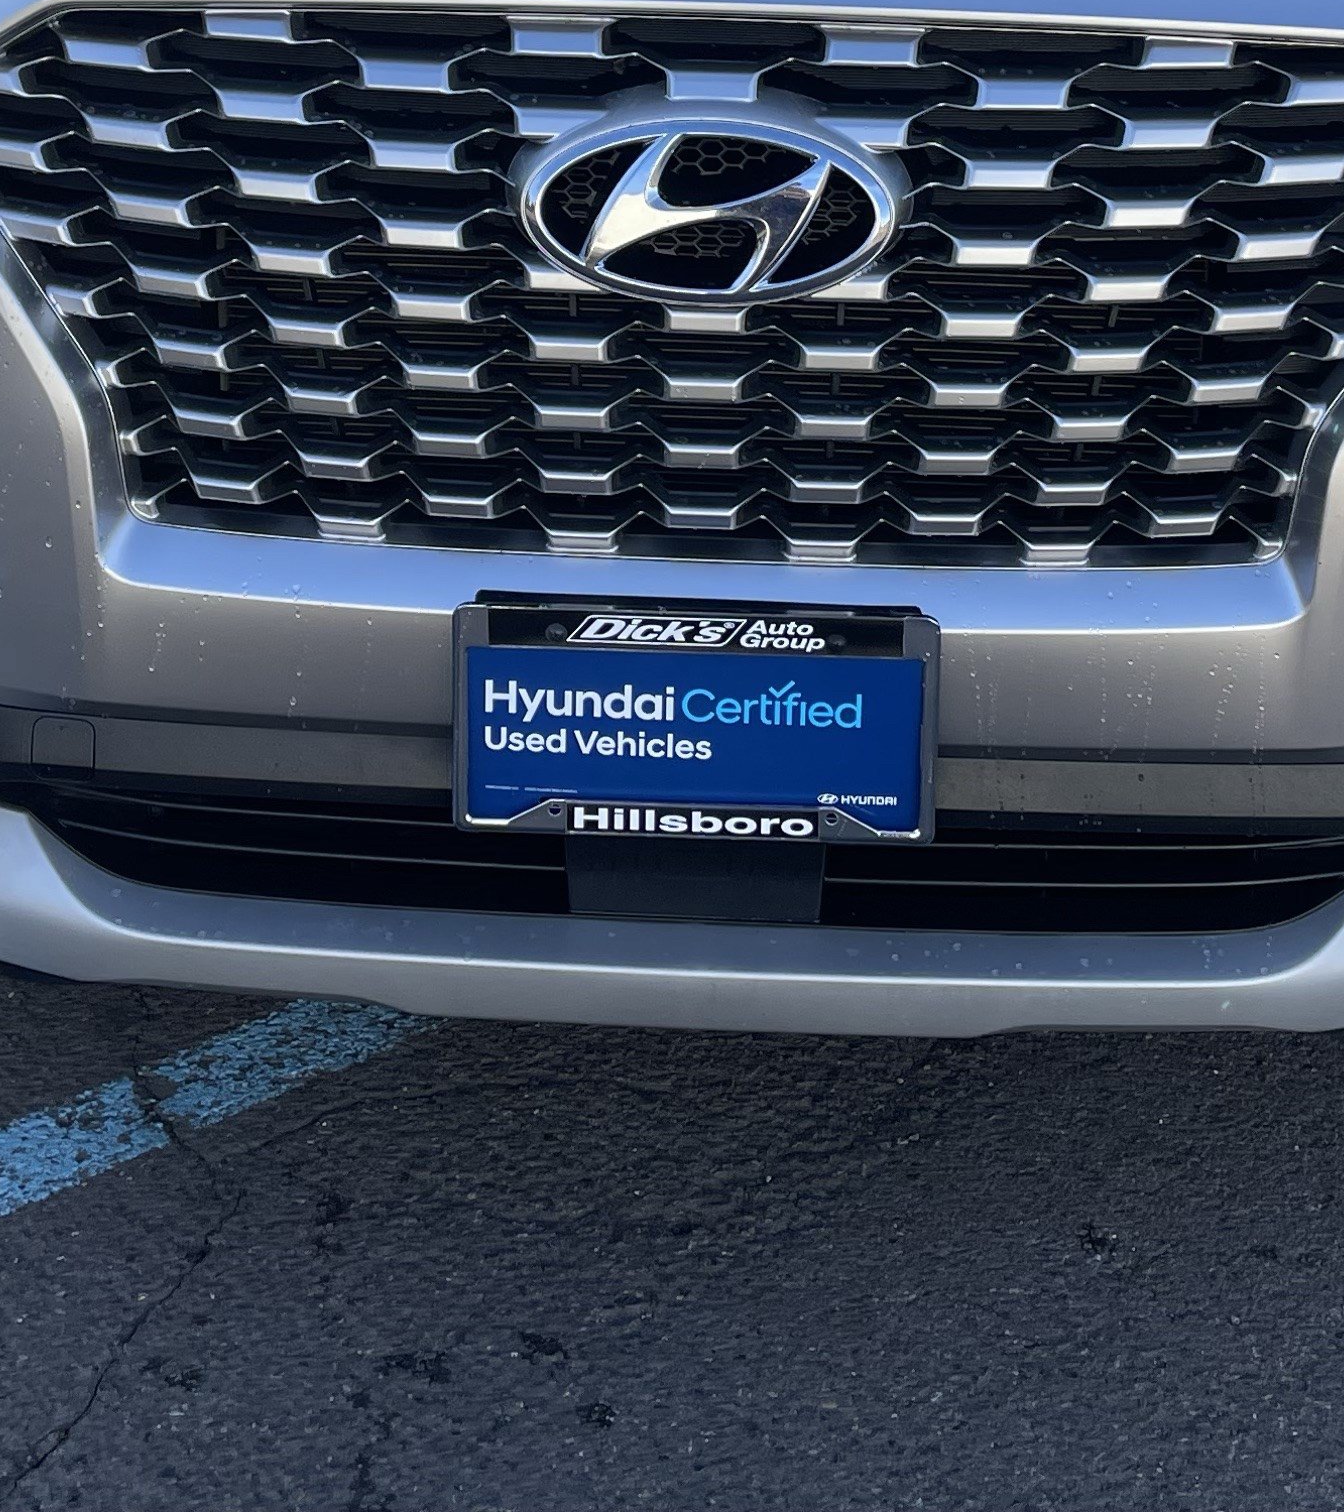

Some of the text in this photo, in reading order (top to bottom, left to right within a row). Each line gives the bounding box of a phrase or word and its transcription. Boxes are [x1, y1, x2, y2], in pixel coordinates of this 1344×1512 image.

[747, 620, 814, 636] Auto
[740, 634, 825, 652] Group
[484, 679, 863, 728] Hyundai Certified
[484, 726, 712, 760] Used Vehicles
[840, 795, 897, 806] HYUNDAI
[574, 807, 813, 837] Hillsboro
